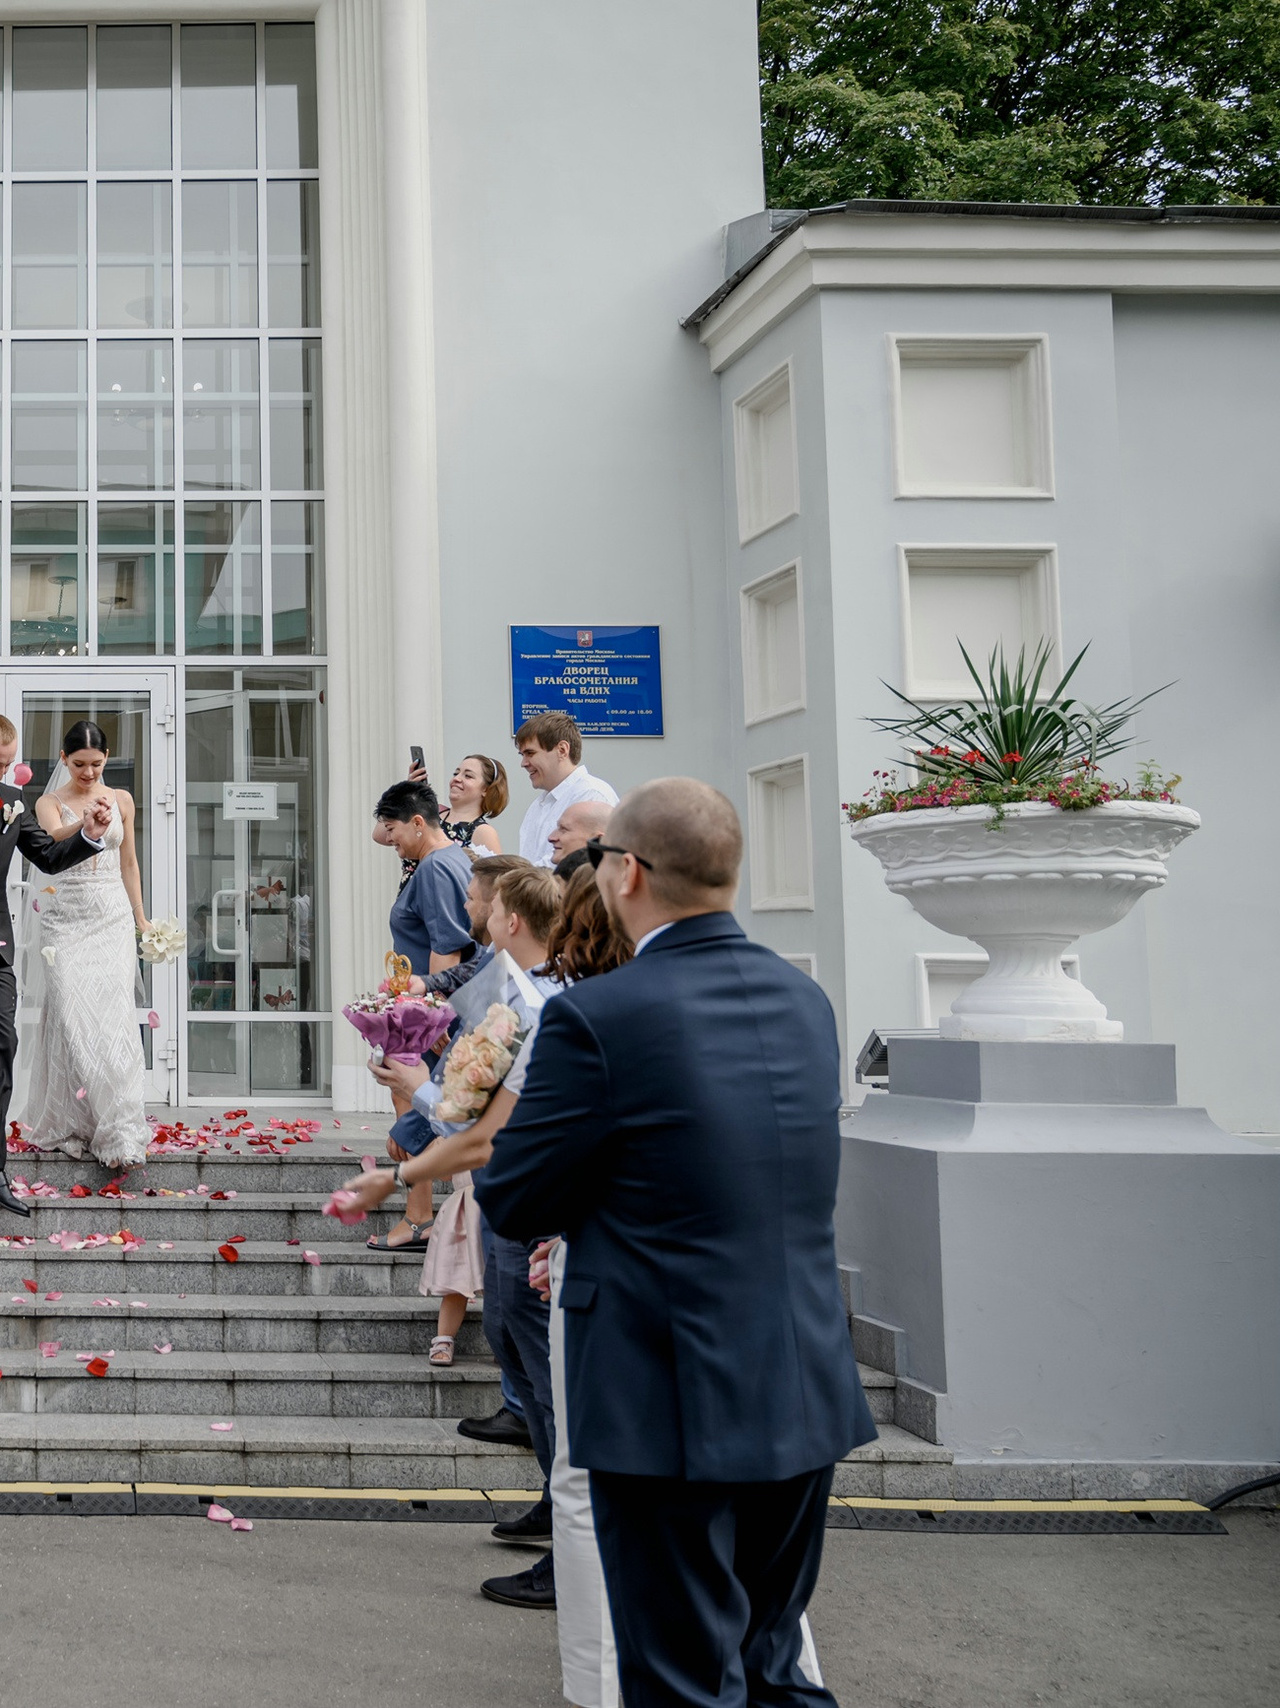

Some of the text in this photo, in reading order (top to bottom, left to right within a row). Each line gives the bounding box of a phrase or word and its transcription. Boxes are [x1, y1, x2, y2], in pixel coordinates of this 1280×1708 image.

[562, 666, 610, 676] ДВОРЕЦ
[534, 676, 638, 685] БРАКОСОЧЕТАНИЯ
[580, 686, 610, 696] ВДНХ
